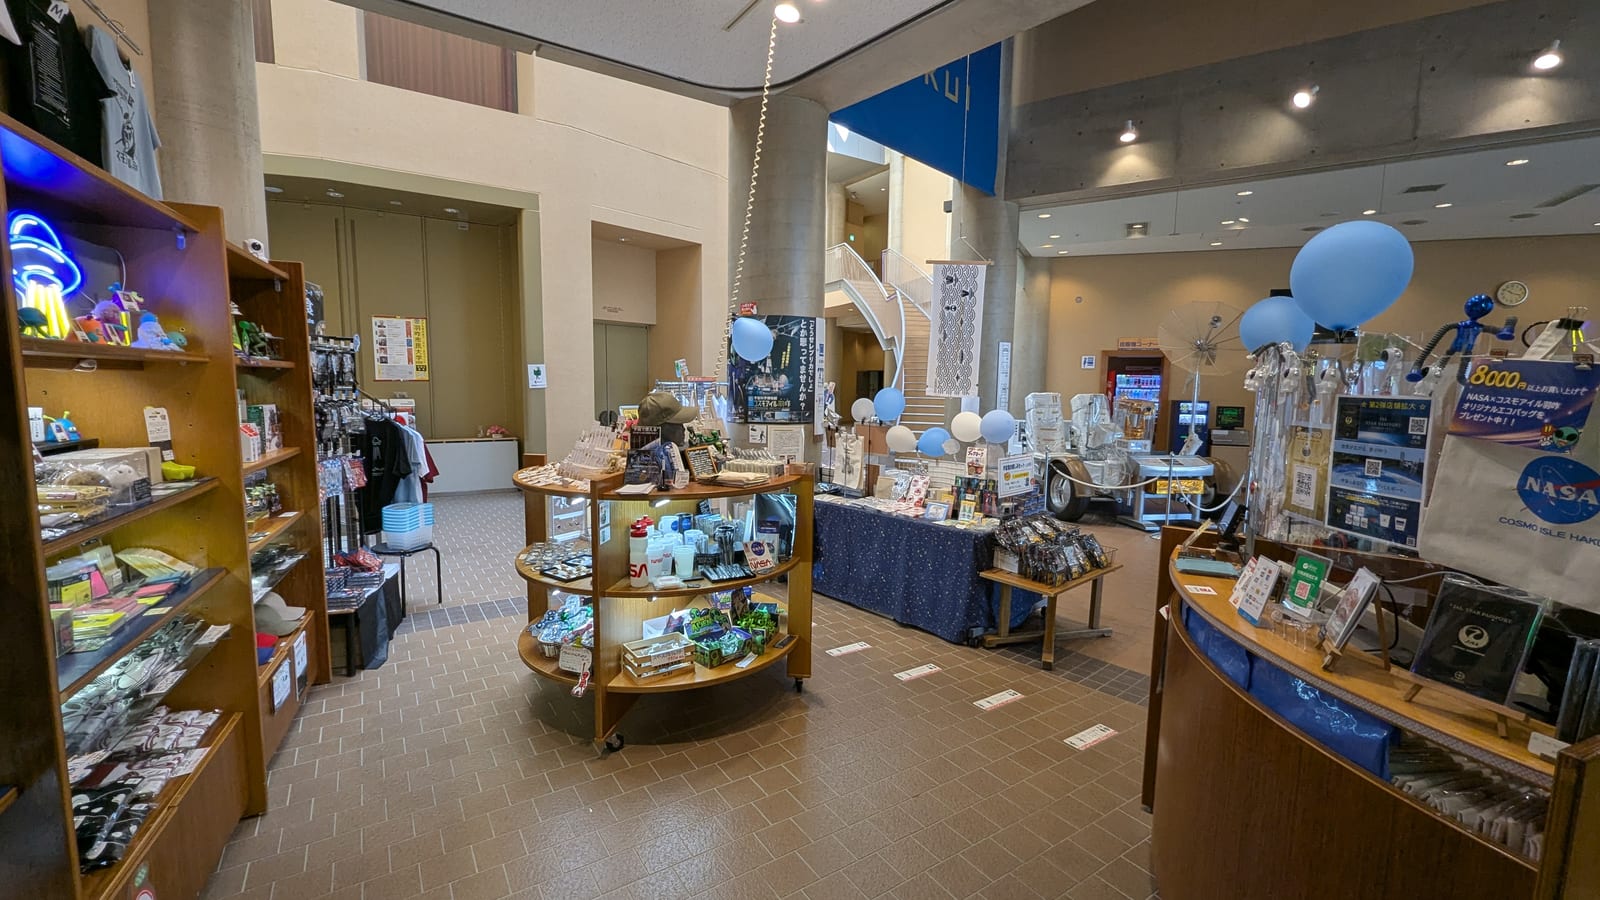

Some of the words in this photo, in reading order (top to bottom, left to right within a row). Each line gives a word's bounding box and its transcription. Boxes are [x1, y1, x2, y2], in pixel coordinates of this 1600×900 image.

[50, 3, 64, 19] M
[1524, 476, 1600, 506] NASA
[1498, 516, 1538, 532] COSMO
[1539, 527, 1567, 539] ISLE
